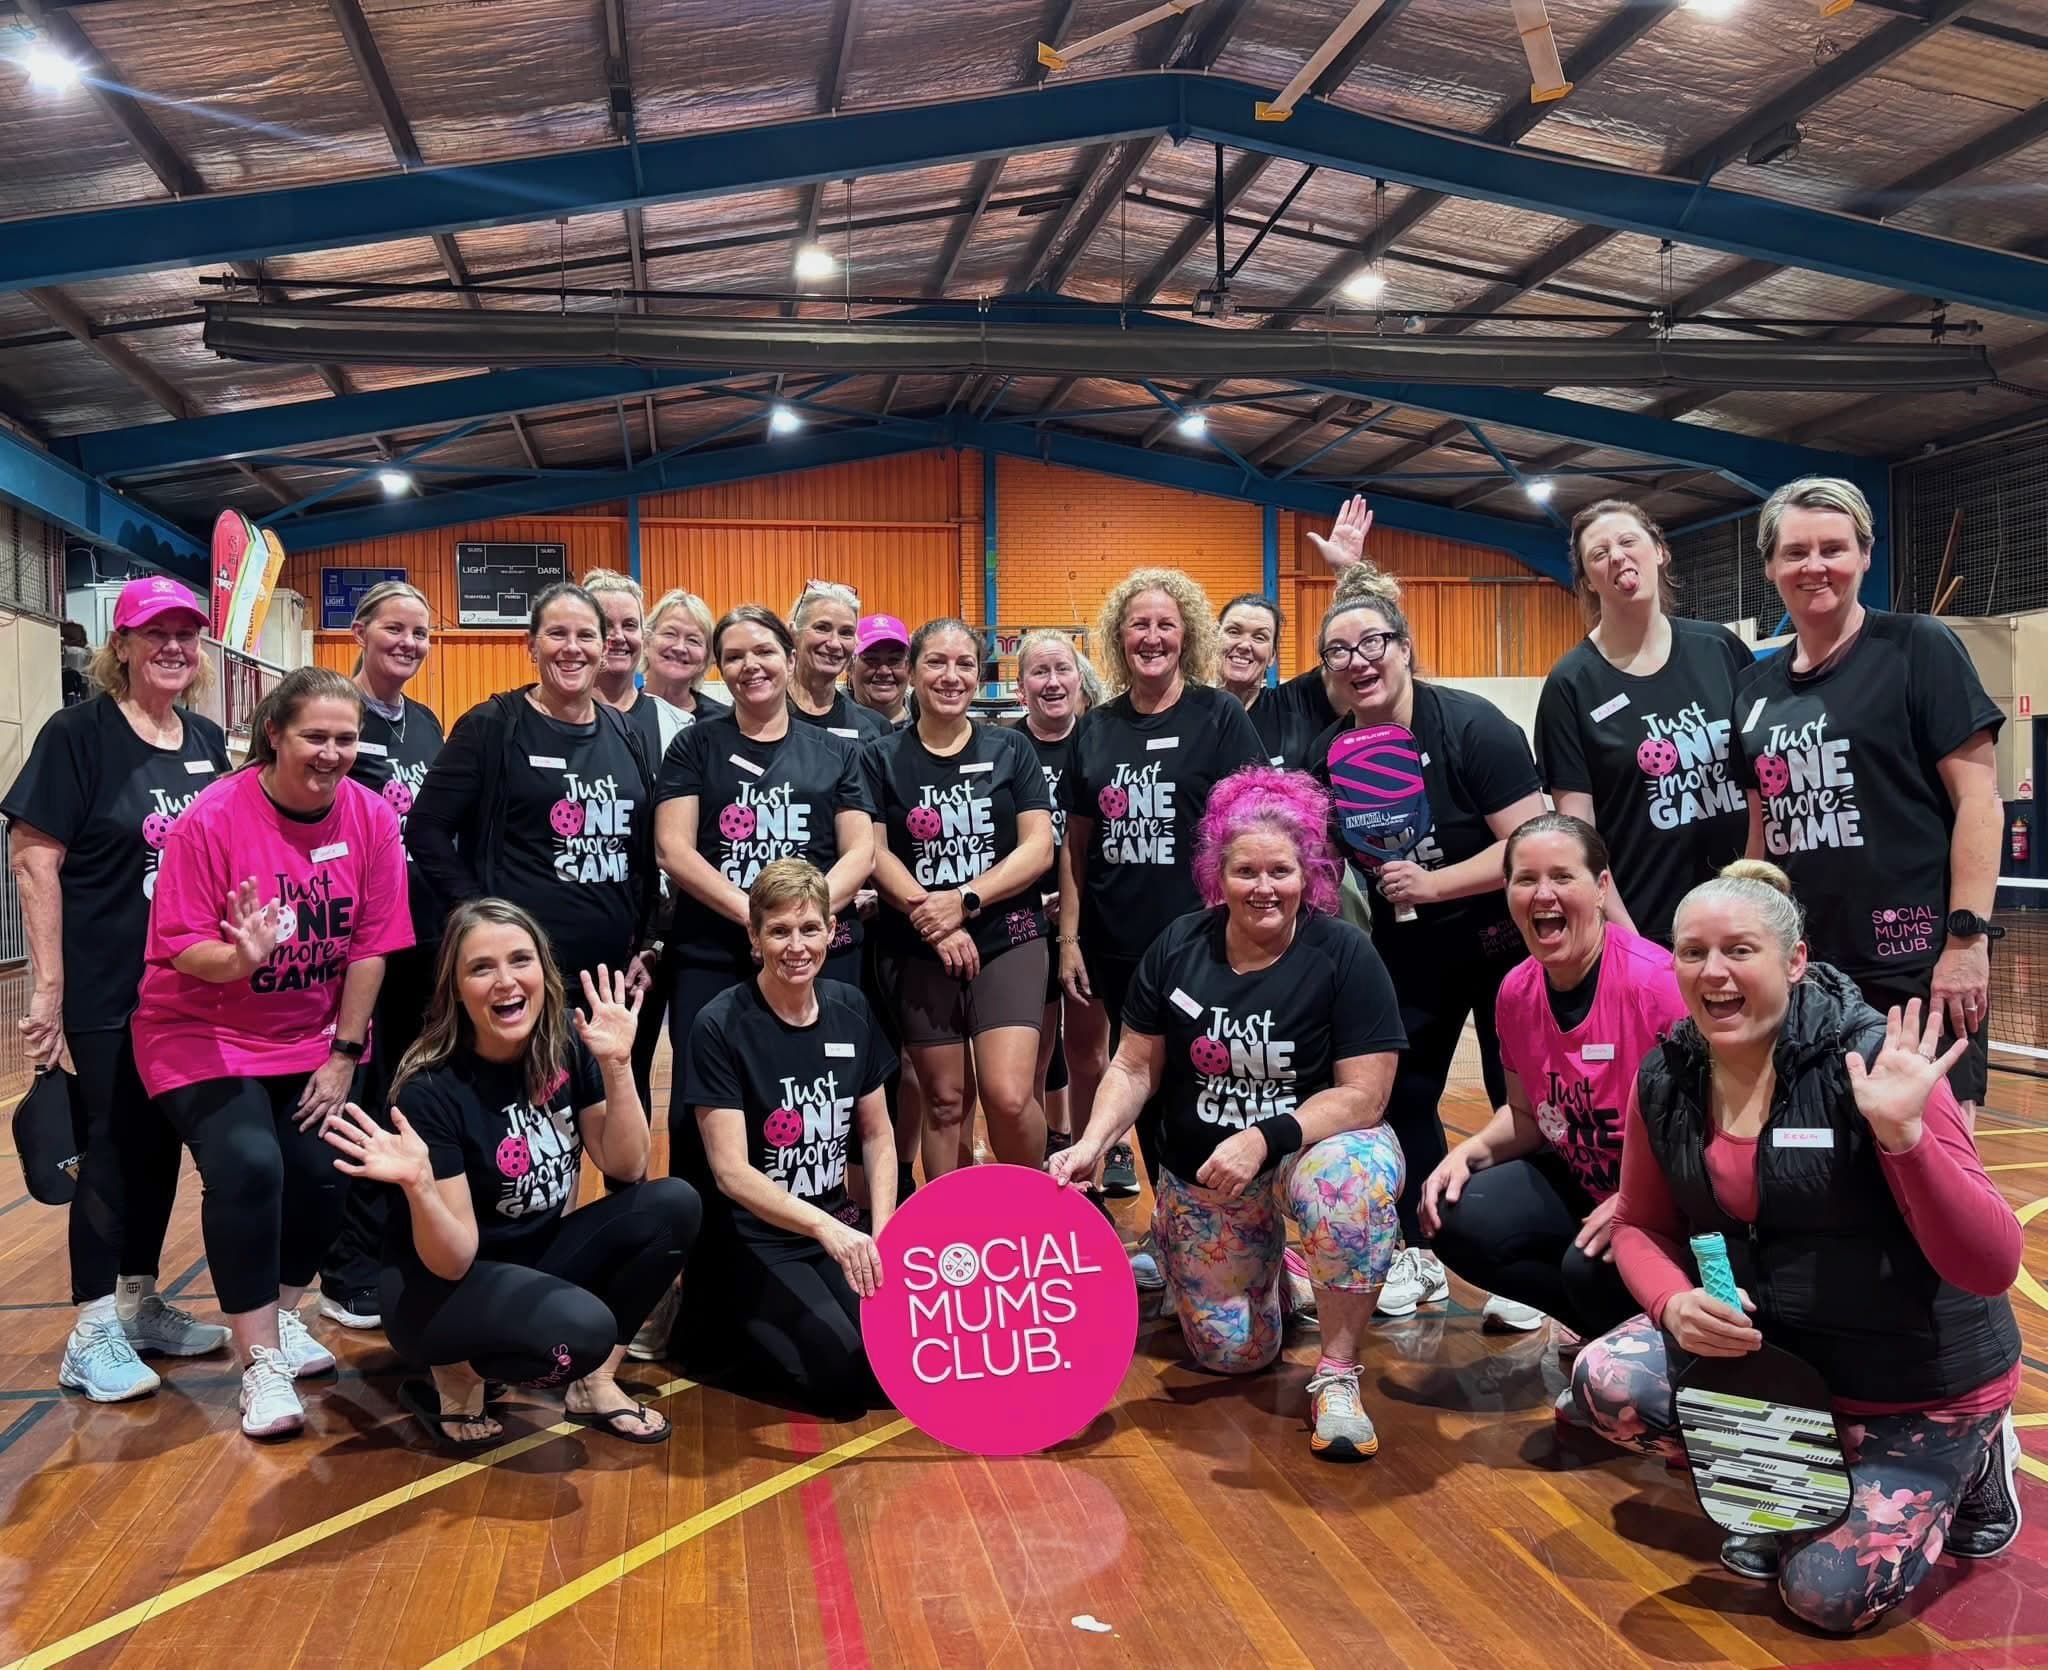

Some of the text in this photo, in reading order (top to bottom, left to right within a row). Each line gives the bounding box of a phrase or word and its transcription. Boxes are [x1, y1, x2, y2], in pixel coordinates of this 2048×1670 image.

[462, 566, 487, 574] LIGHT
[537, 567, 561, 575] DARK
[325, 598, 345, 607] LIGHT
[1641, 701, 1705, 741] Just
[1763, 713, 1828, 757] Just
[1111, 761, 1161, 789] Just
[1658, 762, 1727, 799] more
[1754, 739, 1854, 797] ONE
[563, 773, 618, 803] Just
[735, 780, 794, 809] Just
[919, 779, 976, 810] Just
[1098, 782, 1176, 820] ONE
[1650, 780, 1747, 830] GAME
[1769, 790, 1840, 821] more
[549, 798, 635, 837] ONE
[719, 803, 811, 841] ONE
[906, 797, 995, 840] ONE
[1110, 817, 1162, 839] more
[1764, 810, 1864, 855] GAME
[565, 835, 621, 857] more
[731, 839, 797, 860] more
[923, 834, 985, 860] more
[1102, 837, 1176, 864] GAME
[553, 852, 629, 883] GAME
[274, 869, 333, 908] Just
[1008, 918, 1037, 936] MUMS
[1872, 905, 1939, 924] SOCIAL
[1874, 921, 1933, 940] MUMS
[268, 938, 336, 967] more
[1877, 937, 1932, 956] CLUB.
[251, 955, 345, 994] GAME
[1206, 1006, 1275, 1045] Just
[1190, 1035, 1297, 1080] ONE
[779, 1070, 838, 1112] Just
[1207, 1074, 1280, 1100] more
[1546, 1071, 1594, 1113] Just
[763, 1096, 854, 1147] ONE
[1196, 1089, 1297, 1130] GAME
[778, 1139, 841, 1171] more
[515, 1153, 574, 1197] more
[496, 1170, 574, 1219] GAM
[903, 1231, 1102, 1291] SOCIAL
[908, 1279, 1078, 1338] MUMS
[912, 1327, 1072, 1384] CLUB.
